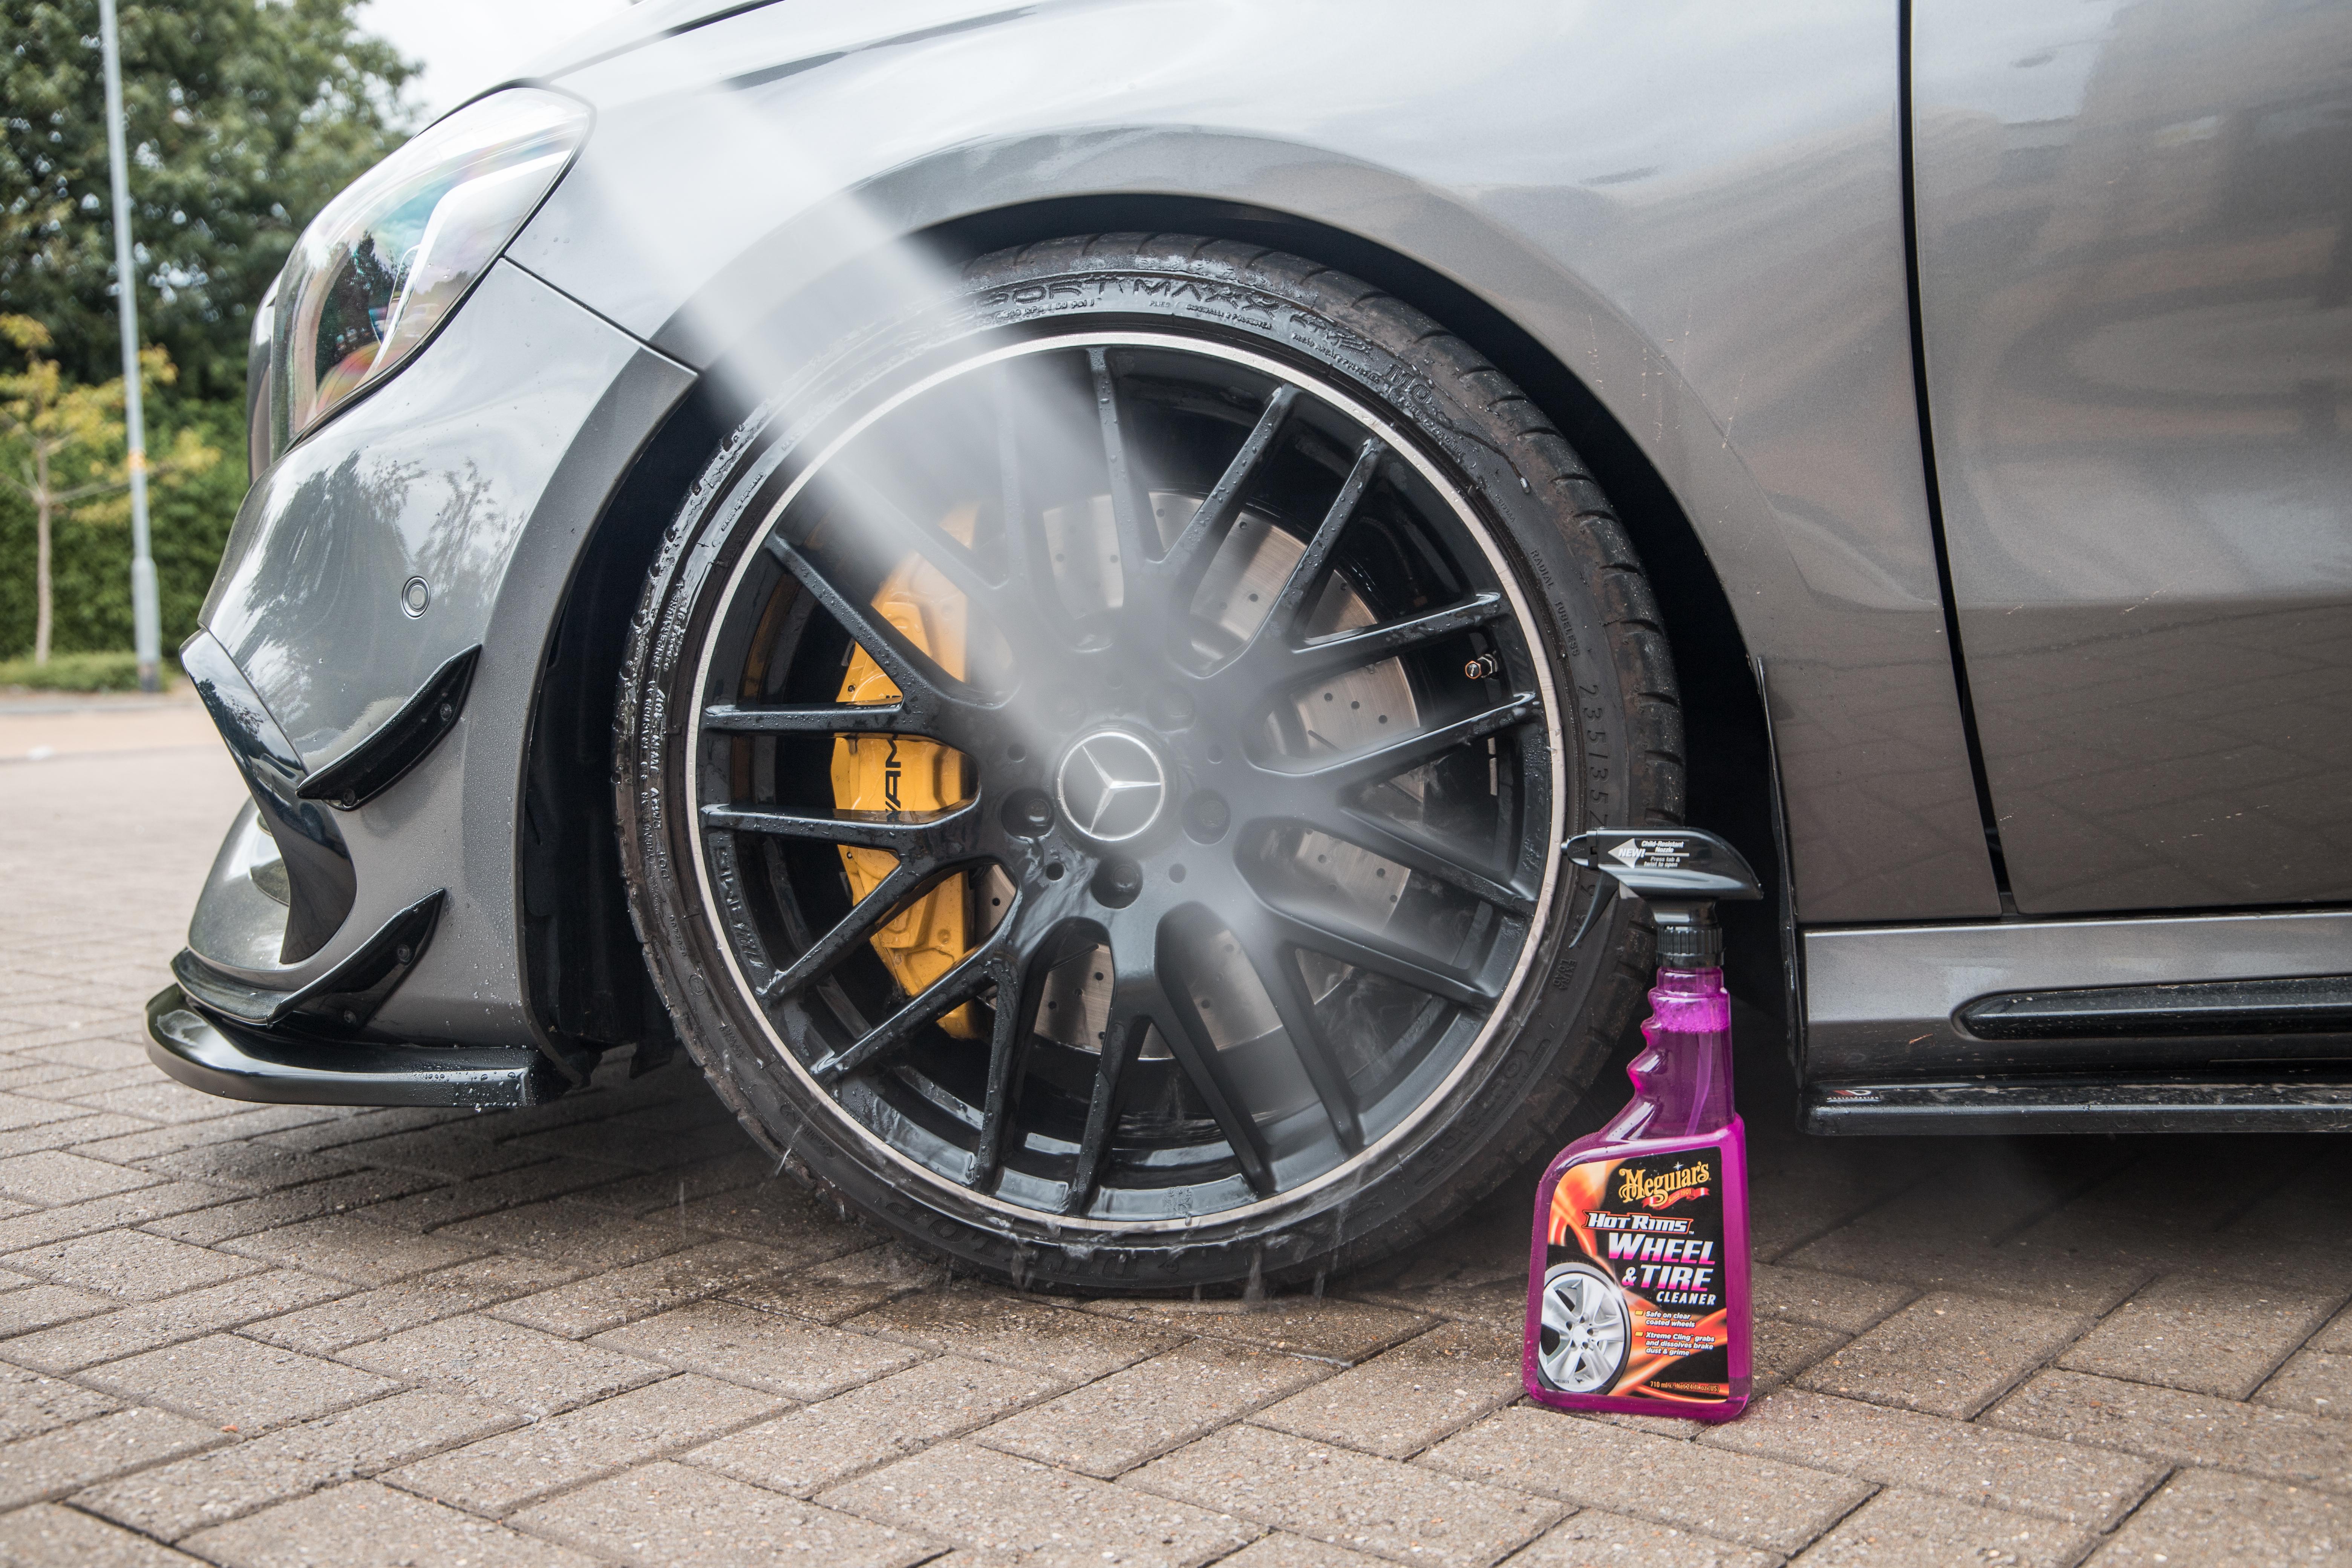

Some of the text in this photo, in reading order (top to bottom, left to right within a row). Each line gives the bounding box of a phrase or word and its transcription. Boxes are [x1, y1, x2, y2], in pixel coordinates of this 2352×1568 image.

[1133, 279, 1280, 320] MAXX
[1530, 549, 1554, 589] RADIAL
[652, 594, 679, 667] TEMPERATURE
[1619, 848, 1646, 858] NEW!
[1553, 959, 1569, 986] LOAD
[1559, 959, 1577, 989] EXTRA
[1619, 1161, 1710, 1207] Meguiar's
[1668, 1193, 1680, 1204] Since
[1588, 1213, 1631, 1228] HOT
[1609, 1232, 1715, 1265] WHEEL
[1622, 1264, 1713, 1291] & TIRE
[1656, 1291, 1717, 1305] CLEANER
[1645, 1331, 1672, 1340] Xtreme
[1660, 1340, 1692, 1349] dissolves
